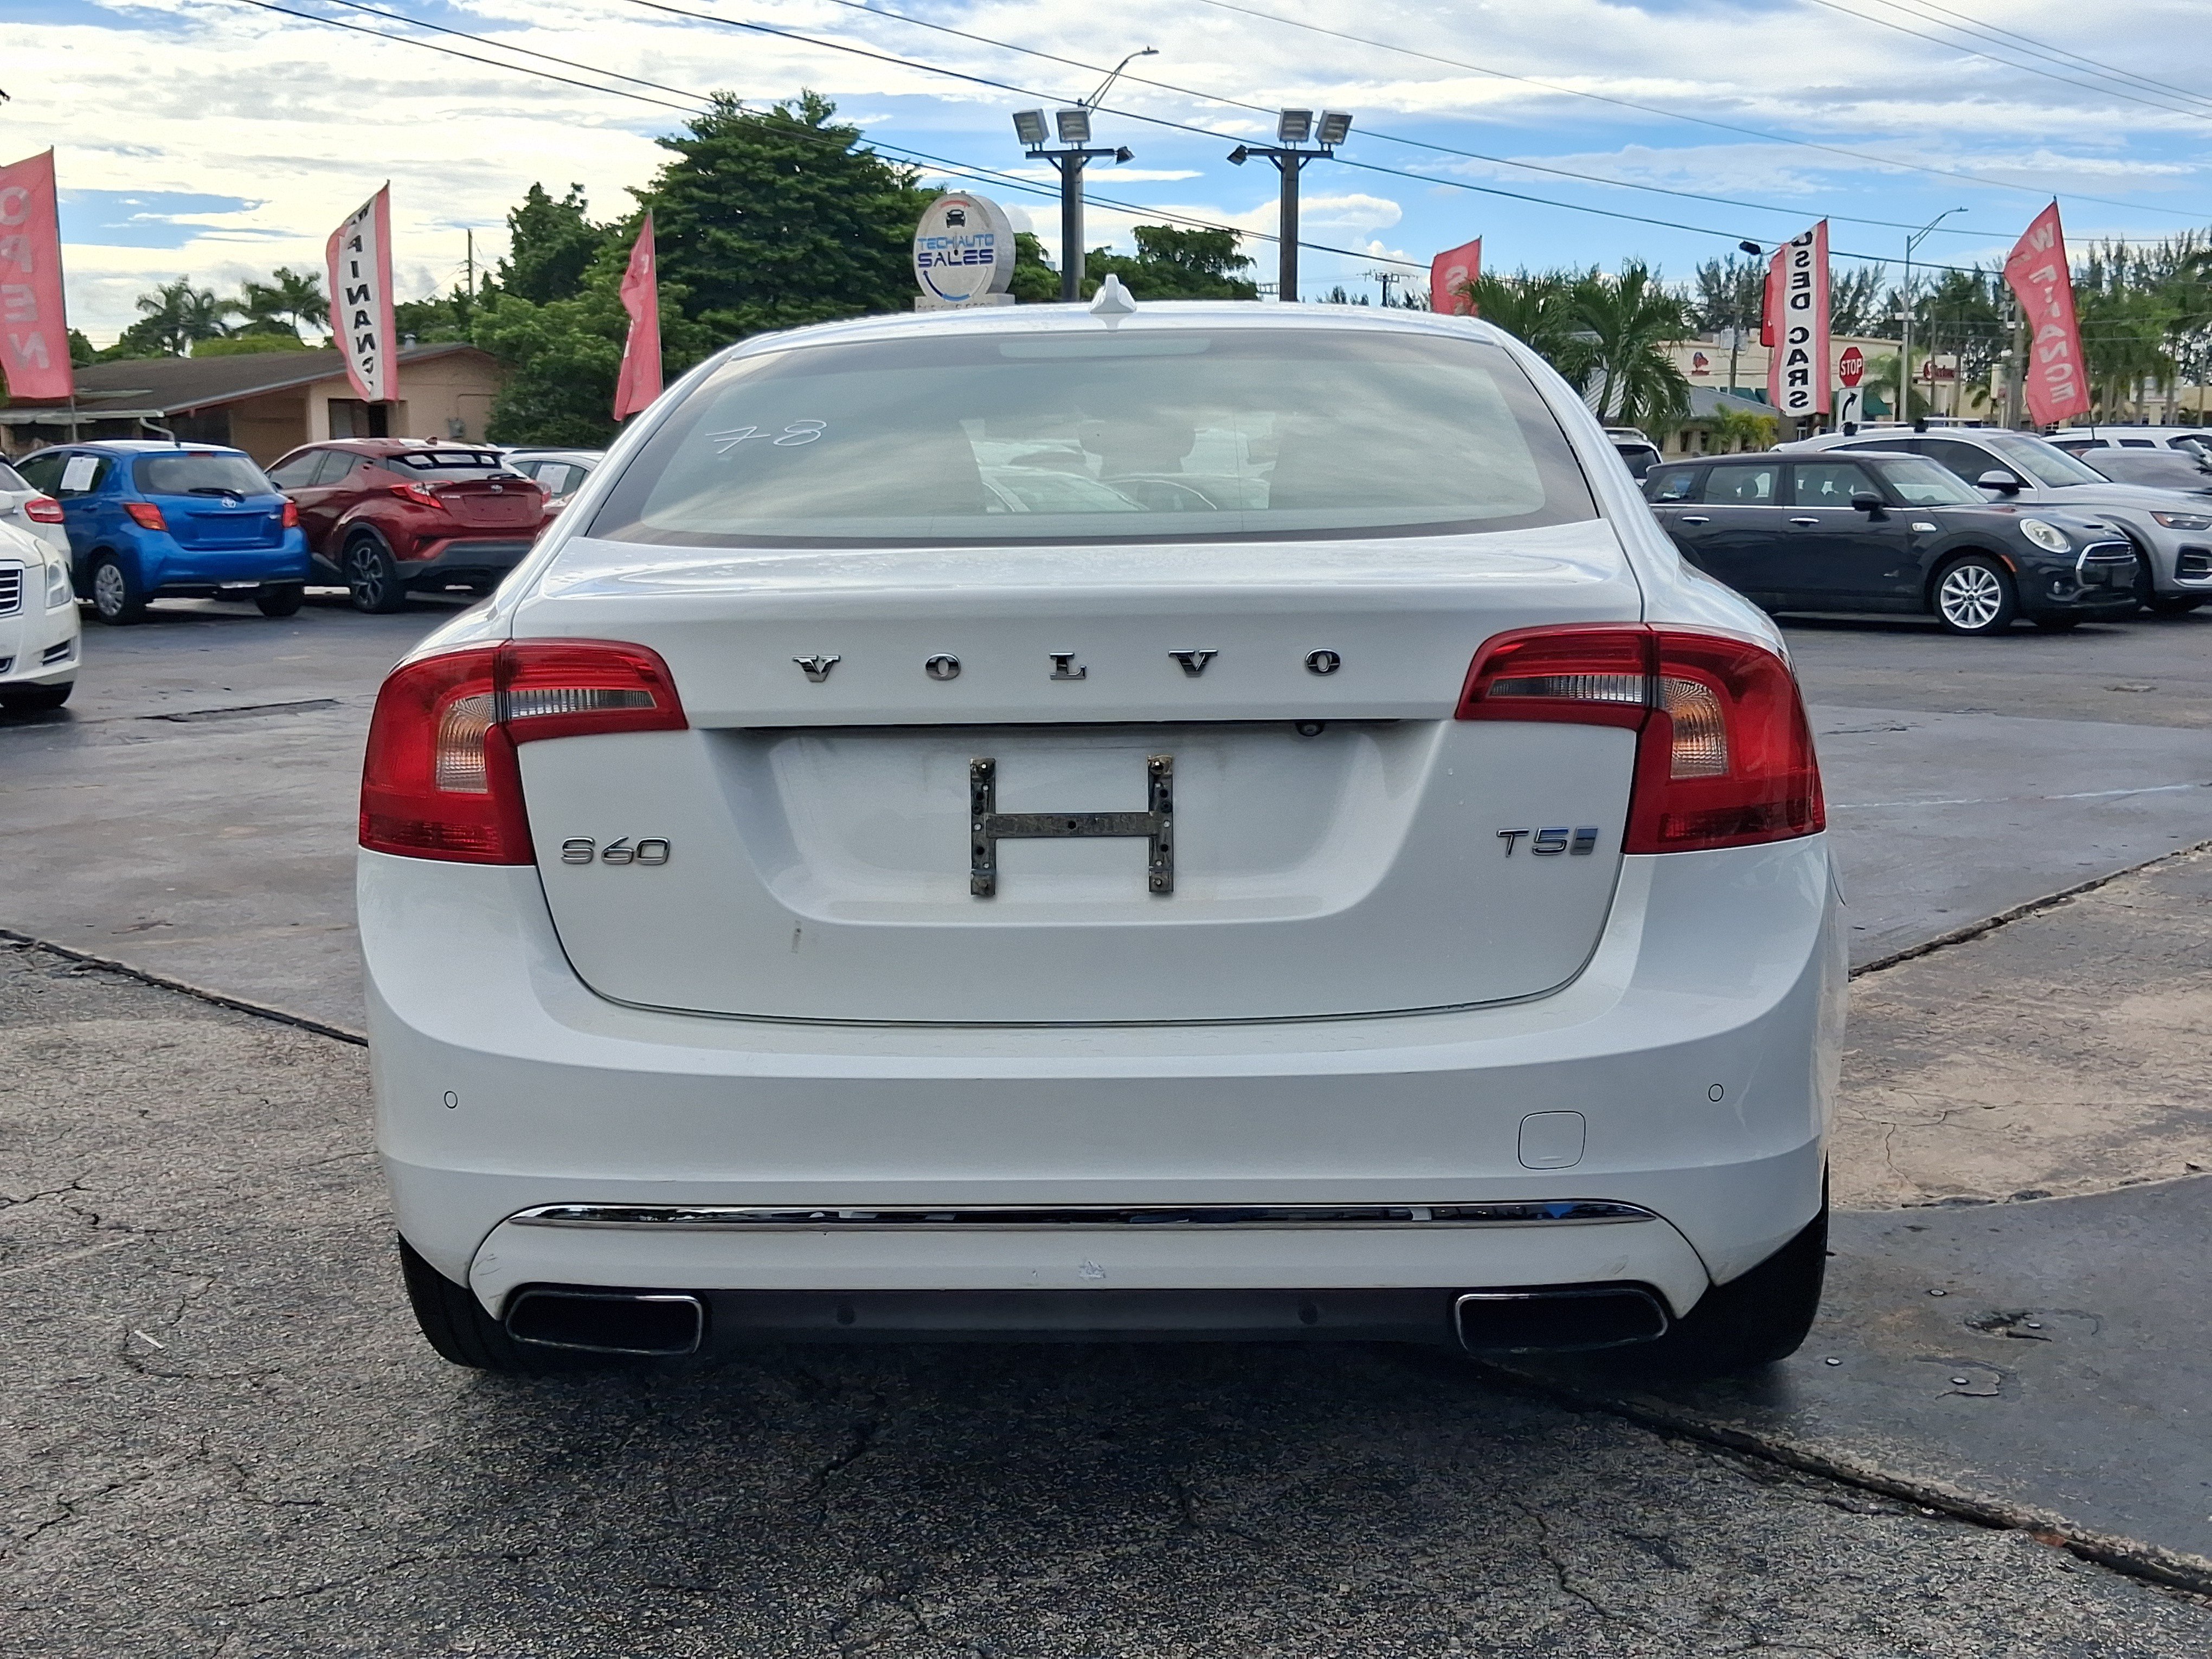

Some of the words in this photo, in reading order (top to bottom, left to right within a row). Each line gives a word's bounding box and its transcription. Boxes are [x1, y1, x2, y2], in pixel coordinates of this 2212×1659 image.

[918, 249, 994, 268] SALES
[1841, 358, 1862, 376] STOP
[792, 648, 1341, 683] VOLVO
[561, 836, 670, 865] S60
[1496, 827, 1569, 858] T5
